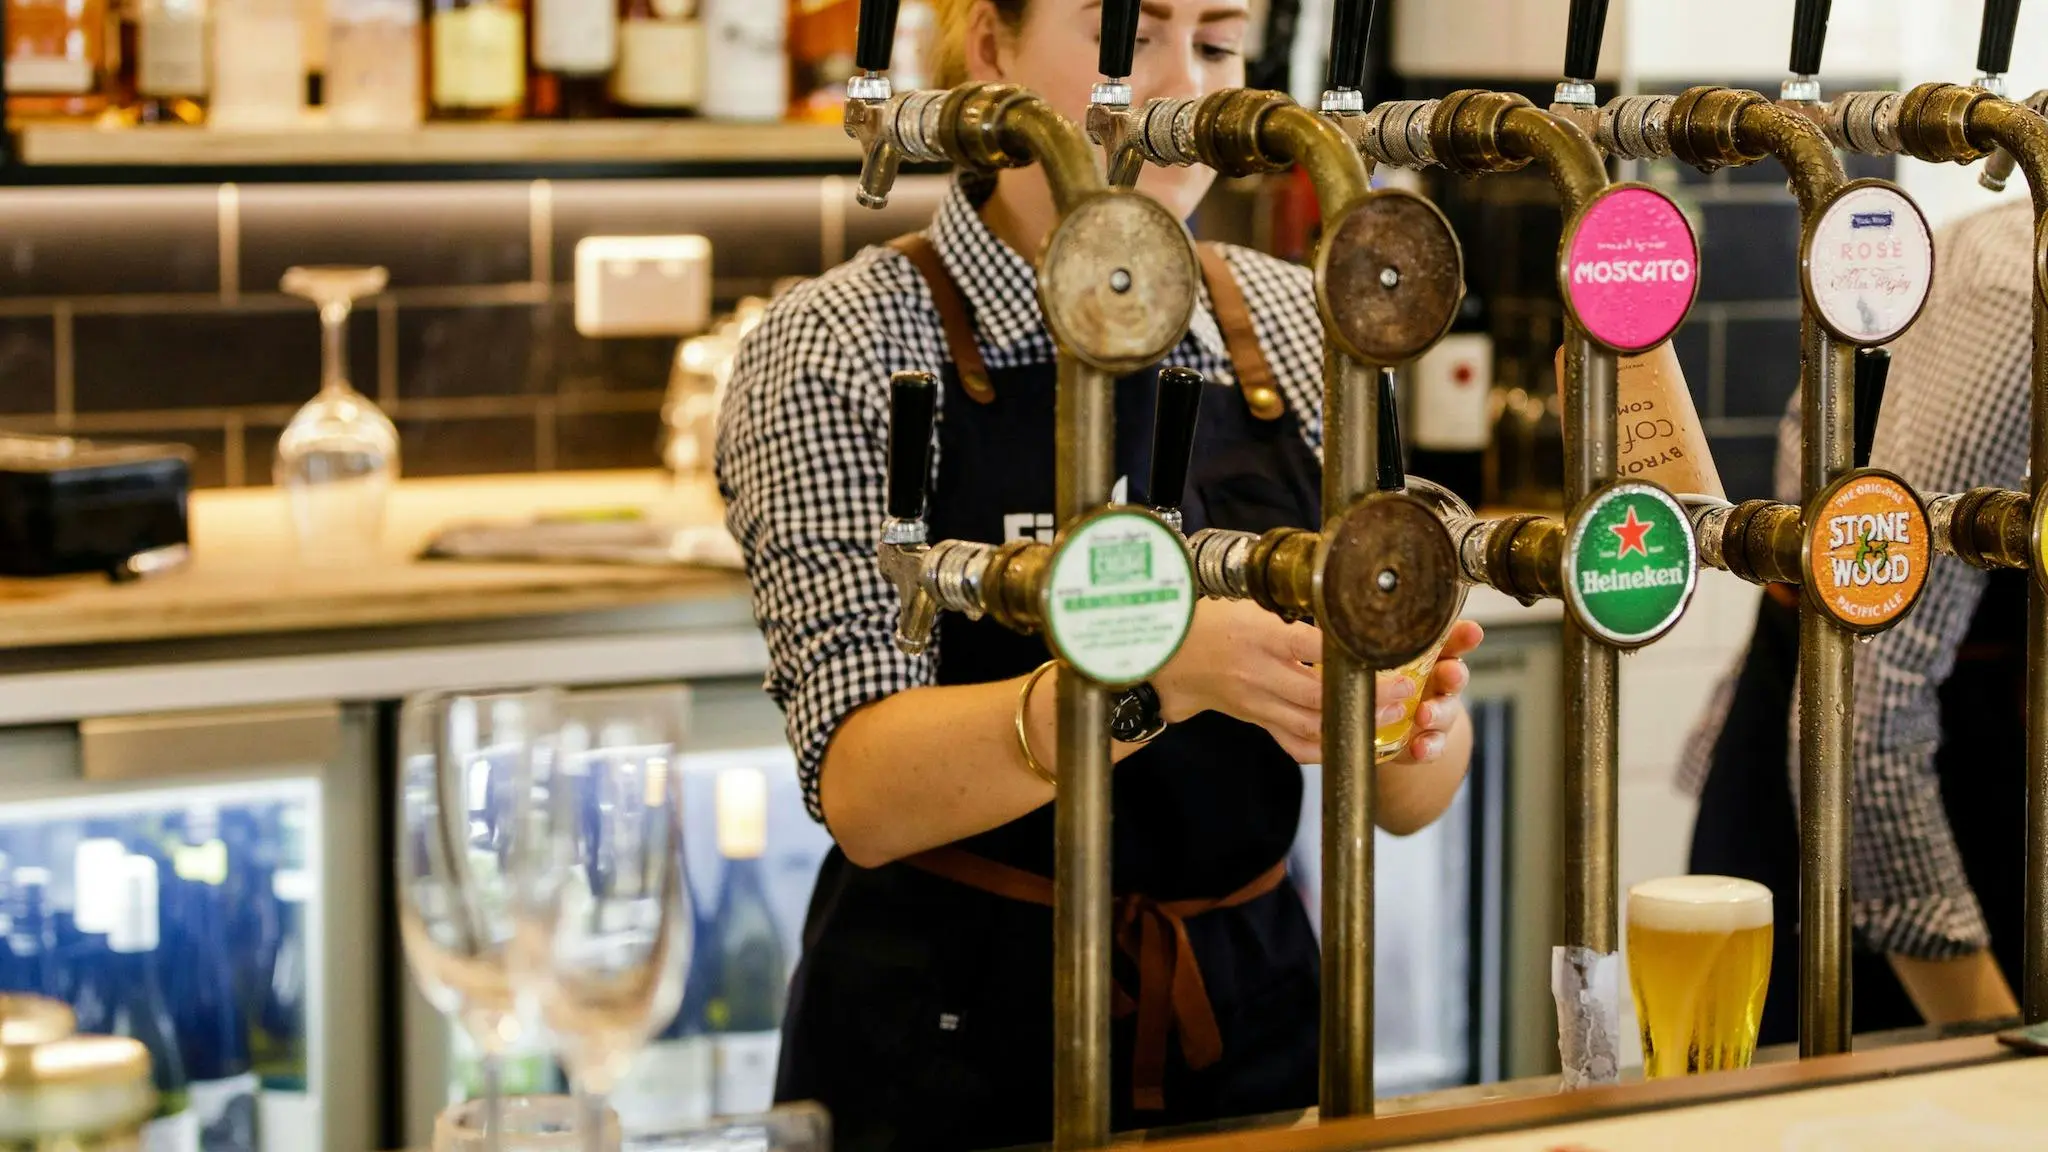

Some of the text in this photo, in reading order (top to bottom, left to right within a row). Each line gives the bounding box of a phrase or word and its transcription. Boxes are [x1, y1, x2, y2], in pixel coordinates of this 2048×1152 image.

[1573, 258, 1690, 284] MOSCATO
[1828, 511, 1911, 549] STONE
[1580, 564, 1685, 595] Heineken
[1831, 553, 1910, 588] WOOD
[1836, 592, 1904, 618] PACIFIC ALE
